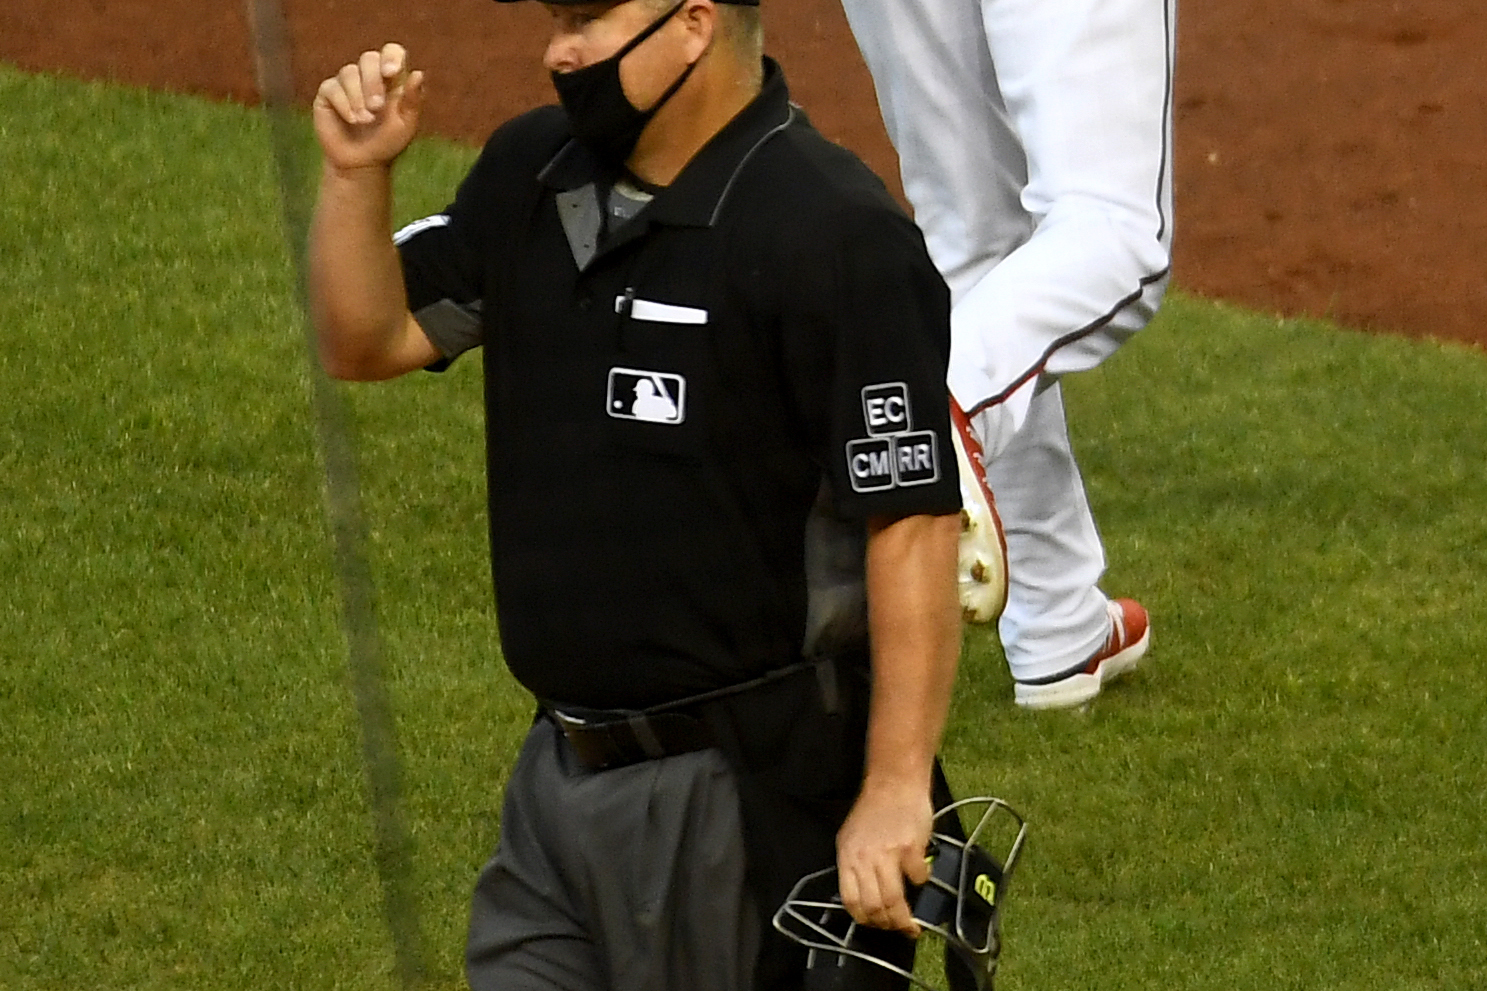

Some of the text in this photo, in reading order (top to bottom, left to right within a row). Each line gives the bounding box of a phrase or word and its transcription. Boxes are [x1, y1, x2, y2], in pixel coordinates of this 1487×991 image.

[866, 396, 905, 426] EC
[852, 443, 932, 478] CM RR
